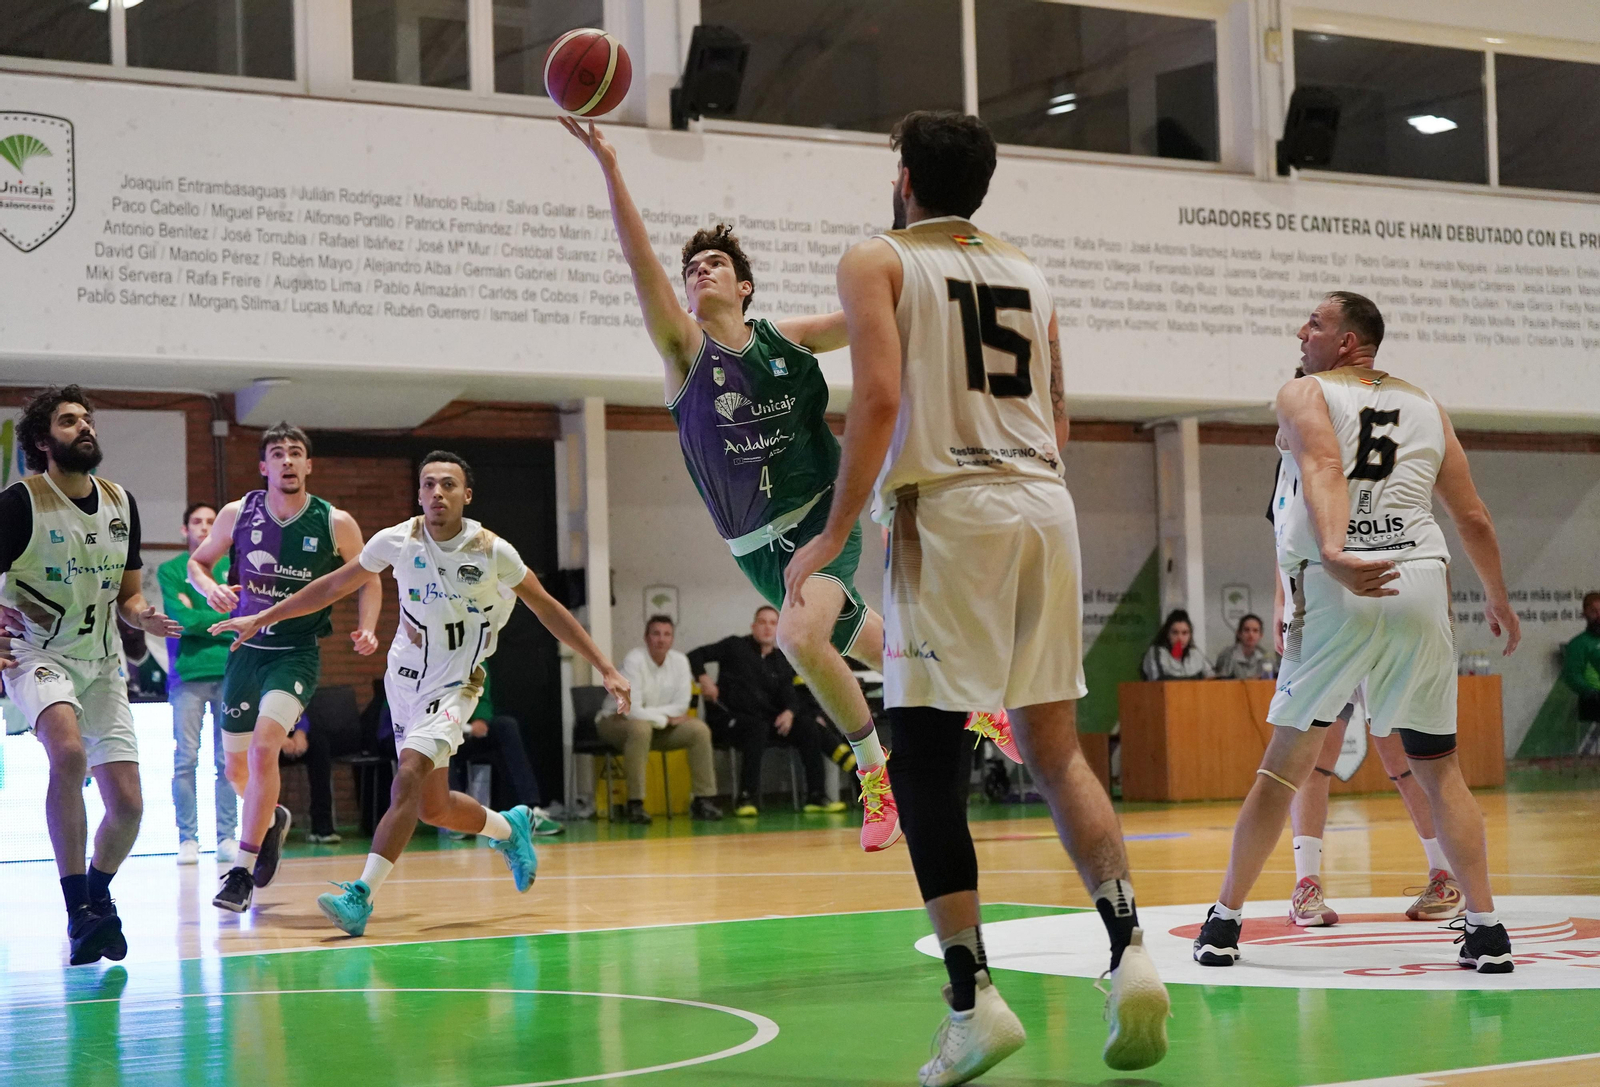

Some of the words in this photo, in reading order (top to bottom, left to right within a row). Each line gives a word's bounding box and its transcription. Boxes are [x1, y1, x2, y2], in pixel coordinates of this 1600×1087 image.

[112, 196, 146, 213] Paco
[150, 198, 200, 216] Cabello
[212, 202, 252, 222] Miguel
[257, 205, 293, 222] Pérez
[304, 208, 350, 225] Alfonso
[354, 211, 394, 228] Portillo
[406, 214, 446, 231] Patrick
[522, 222, 555, 238] Pedro
[178, 177, 286, 201] Entrambasaguas
[413, 193, 457, 210] Manolo
[461, 196, 496, 212] Rubia
[506, 199, 538, 215] Salva
[740, 214, 776, 230] Ramos
[103, 219, 154, 237] Antonio
[221, 226, 252, 242] José
[256, 228, 306, 245] Torrubia
[319, 231, 359, 248] Rafael
[416, 237, 444, 252] José
[468, 240, 490, 255] Mur
[1178, 207, 1271, 230] JUGADORES
[1276, 213, 1297, 231] DE
[1301, 215, 1371, 235] CANTERA
[1375, 220, 1406, 238] QUE
[1410, 222, 1442, 241] HAN
[1446, 224, 1523, 246] DEBUTADO
[1527, 228, 1556, 247] CON
[1560, 231, 1576, 249] EL
[95, 241, 133, 258] David
[138, 243, 156, 259] Gil
[170, 245, 218, 262] Manolo
[222, 248, 259, 265] Pérez
[272, 251, 313, 268] Rubén
[318, 253, 352, 273] Mayo
[364, 256, 421, 275] Alejandro
[424, 259, 451, 275] Alba
[463, 262, 511, 278] Germán
[515, 264, 556, 280] Gabriel
[568, 267, 600, 283] Manu
[604, 269, 633, 284] Góme
[78, 286, 115, 303] Pablo
[120, 288, 177, 306] Sánchez
[189, 292, 237, 312] Morgan
[241, 294, 280, 310] Stilma
[292, 296, 328, 313] Lucas
[332, 298, 373, 314] Muñoz
[384, 301, 423, 317] Rubén
[427, 303, 480, 319] Guerrero
[490, 306, 528, 321] Ismael
[532, 308, 569, 323] Tamba
[580, 310, 620, 326] Francis
[86, 264, 114, 281] Miki
[118, 266, 172, 283] Servera
[186, 269, 218, 285] Rafa
[222, 271, 260, 287] Freire
[274, 273, 326, 293] Augusto
[331, 276, 361, 292] Lima
[374, 278, 410, 294] Pablo
[479, 283, 518, 299] Carlos
[522, 285, 536, 300] de
[541, 286, 578, 302] Cobos
[590, 289, 620, 307] Pepe
[945, 277, 1033, 399] 15
[751, 395, 796, 416] Unicaja
[1000, 447, 1036, 458] RUFINO
[1347, 405, 1400, 482] 6
[759, 466, 773, 499] 4
[274, 565, 312, 579] Unicaja
[445, 620, 465, 651] 11
